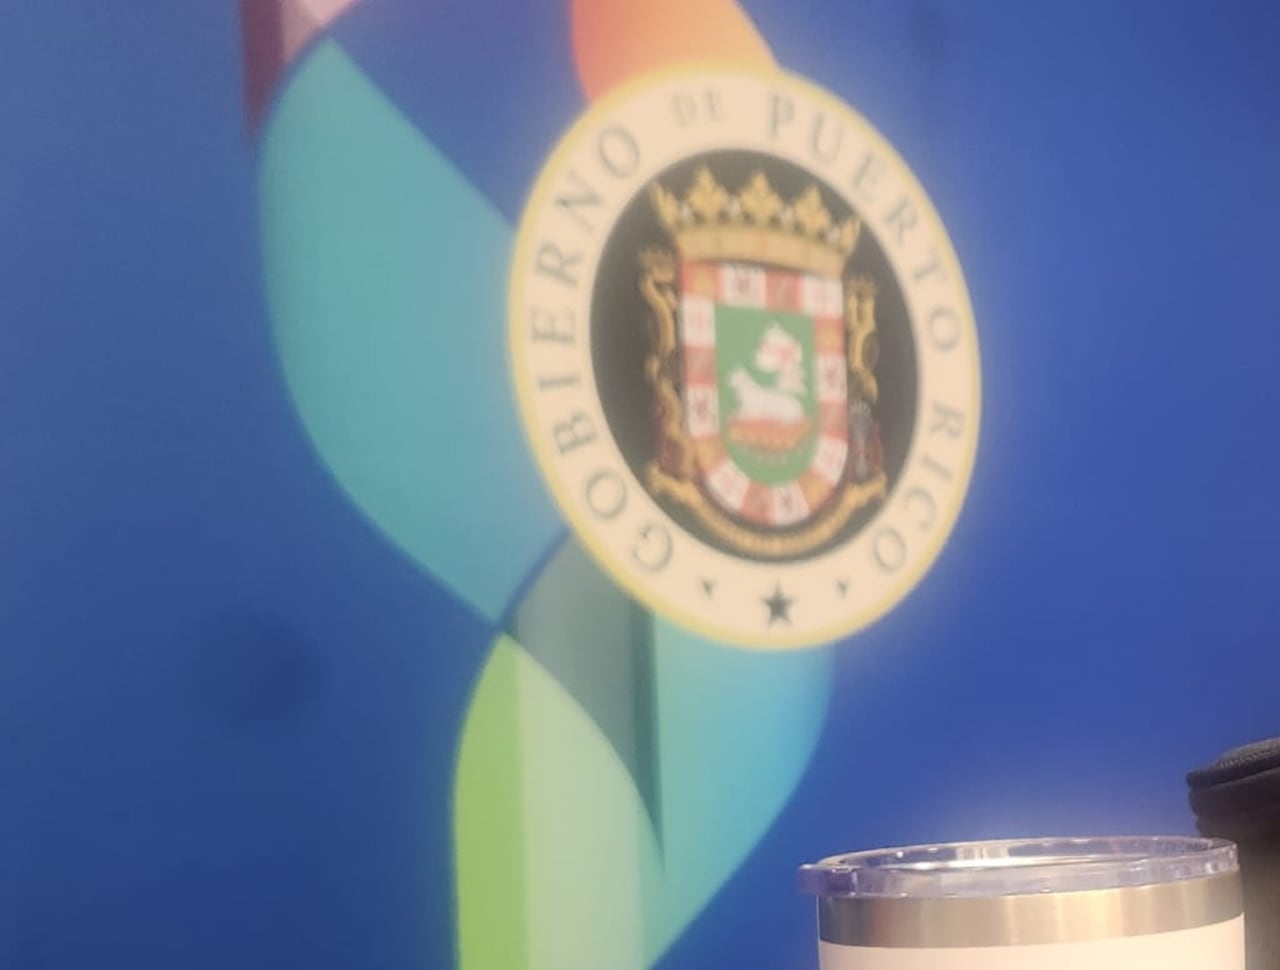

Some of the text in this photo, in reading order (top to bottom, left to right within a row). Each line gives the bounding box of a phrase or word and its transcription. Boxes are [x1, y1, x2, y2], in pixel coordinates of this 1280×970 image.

[531, 124, 675, 574] GOBIERNO
[766, 93, 963, 353] PUERTO
[873, 401, 967, 573] RICO
